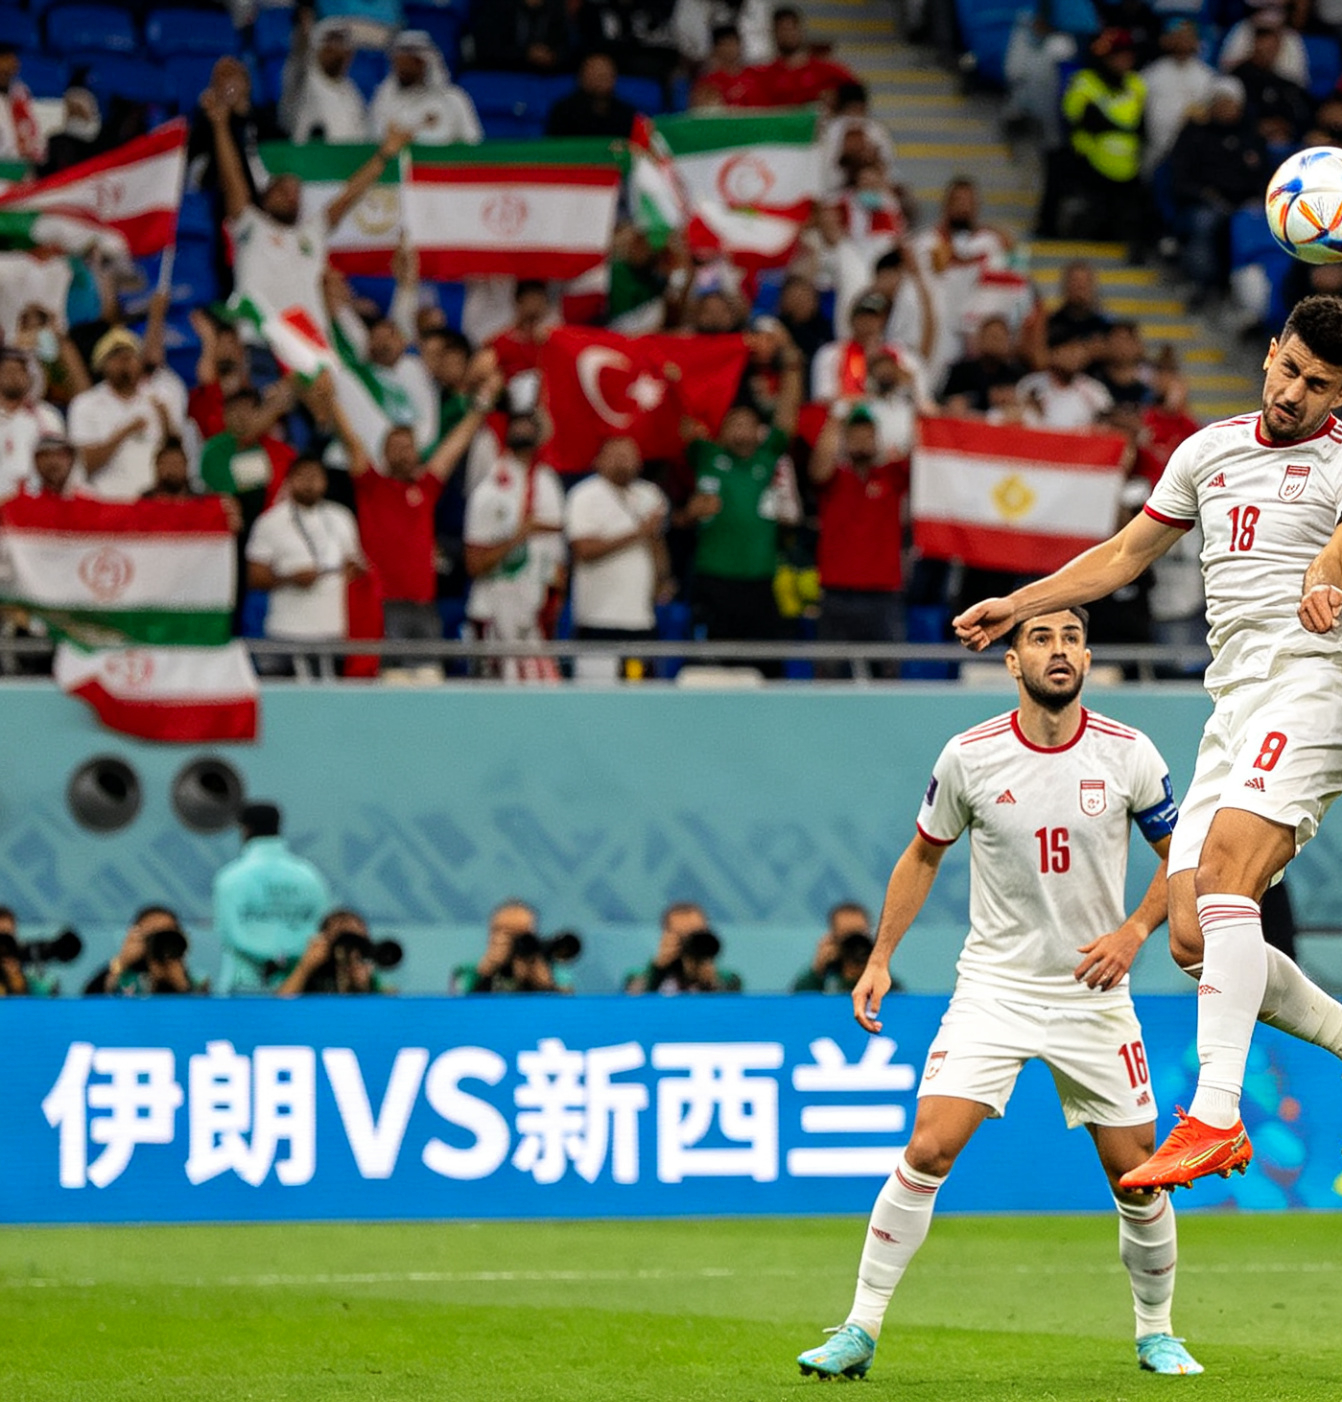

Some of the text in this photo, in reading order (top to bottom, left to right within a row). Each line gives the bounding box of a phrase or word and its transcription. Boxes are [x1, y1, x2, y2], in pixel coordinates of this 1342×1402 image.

[1227, 505, 1261, 552] 18
[1252, 731, 1288, 772] 8
[1117, 1040, 1149, 1089] 18
[43, 1039, 914, 1188] 伊朗VS新西兰
